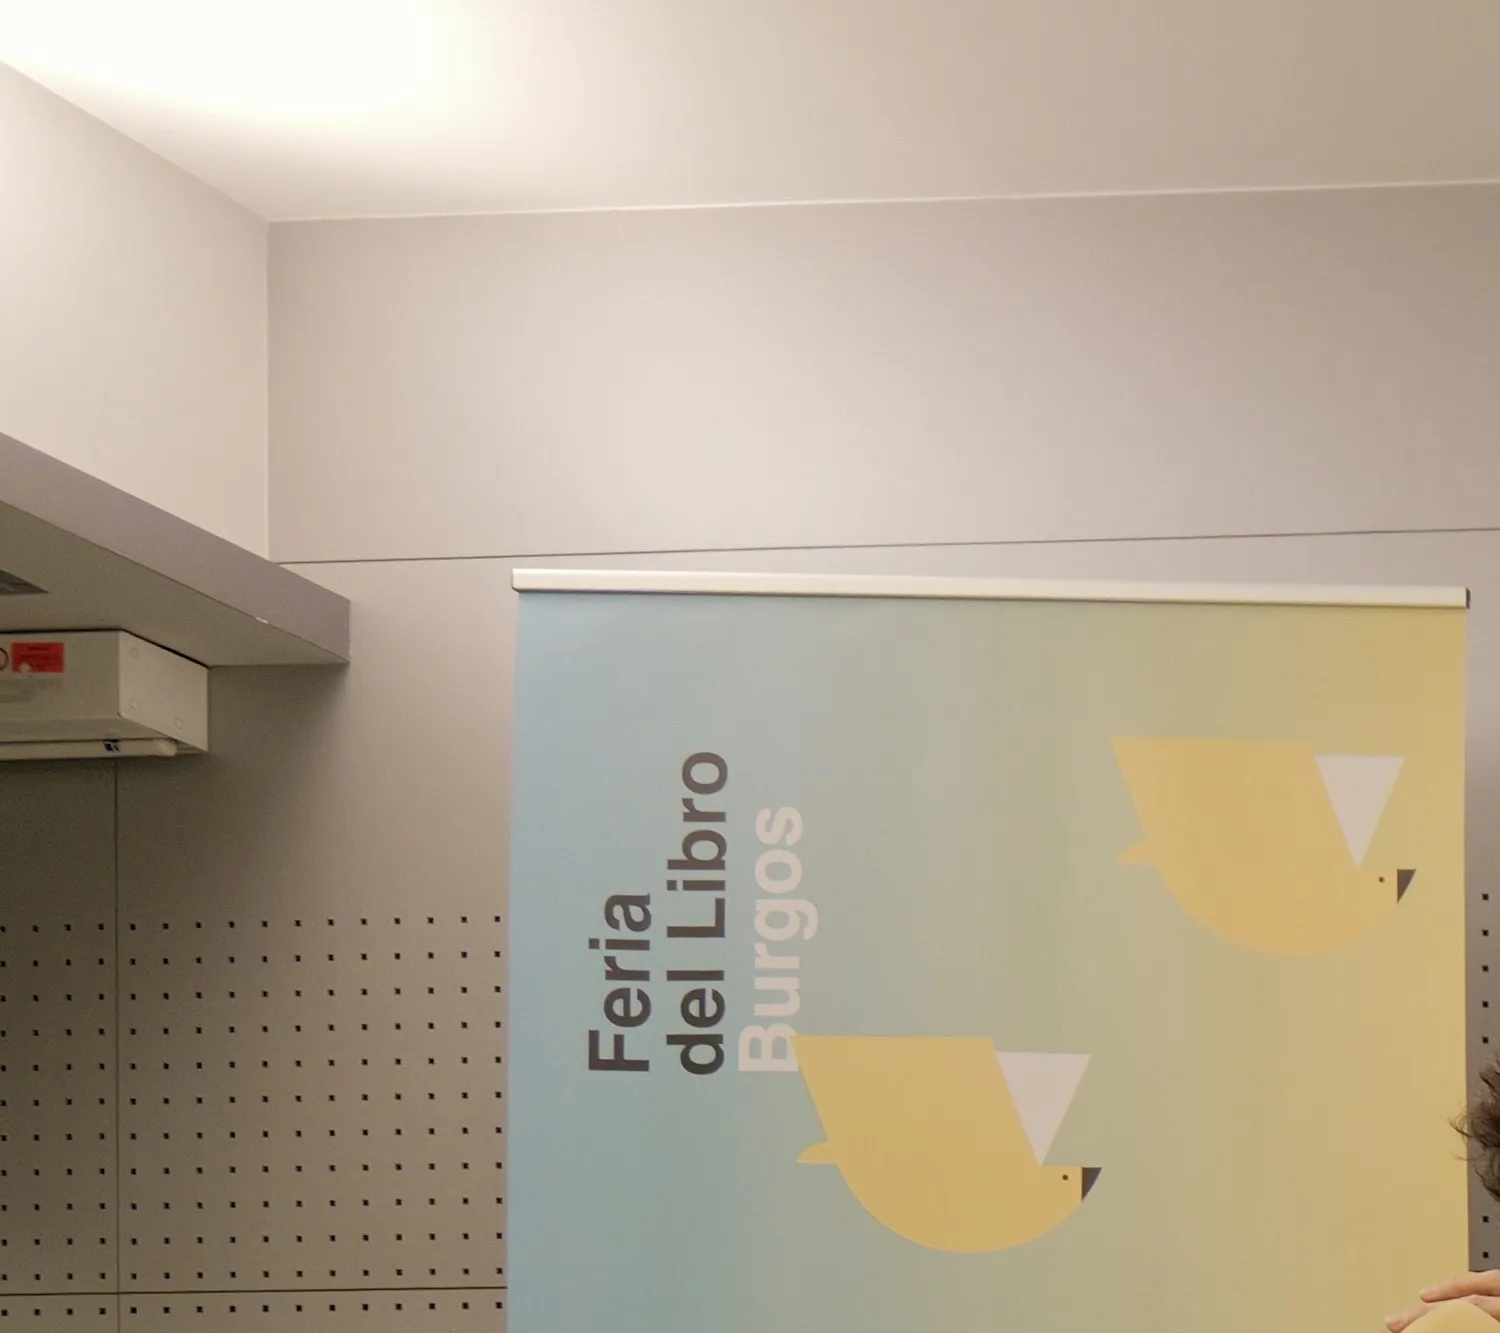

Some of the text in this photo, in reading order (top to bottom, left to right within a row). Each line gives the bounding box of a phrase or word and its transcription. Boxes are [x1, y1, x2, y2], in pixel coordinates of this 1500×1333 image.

[588, 893, 652, 1072] Feria
[666, 751, 729, 1075] del Libro
[738, 806, 819, 1072] Burgos
